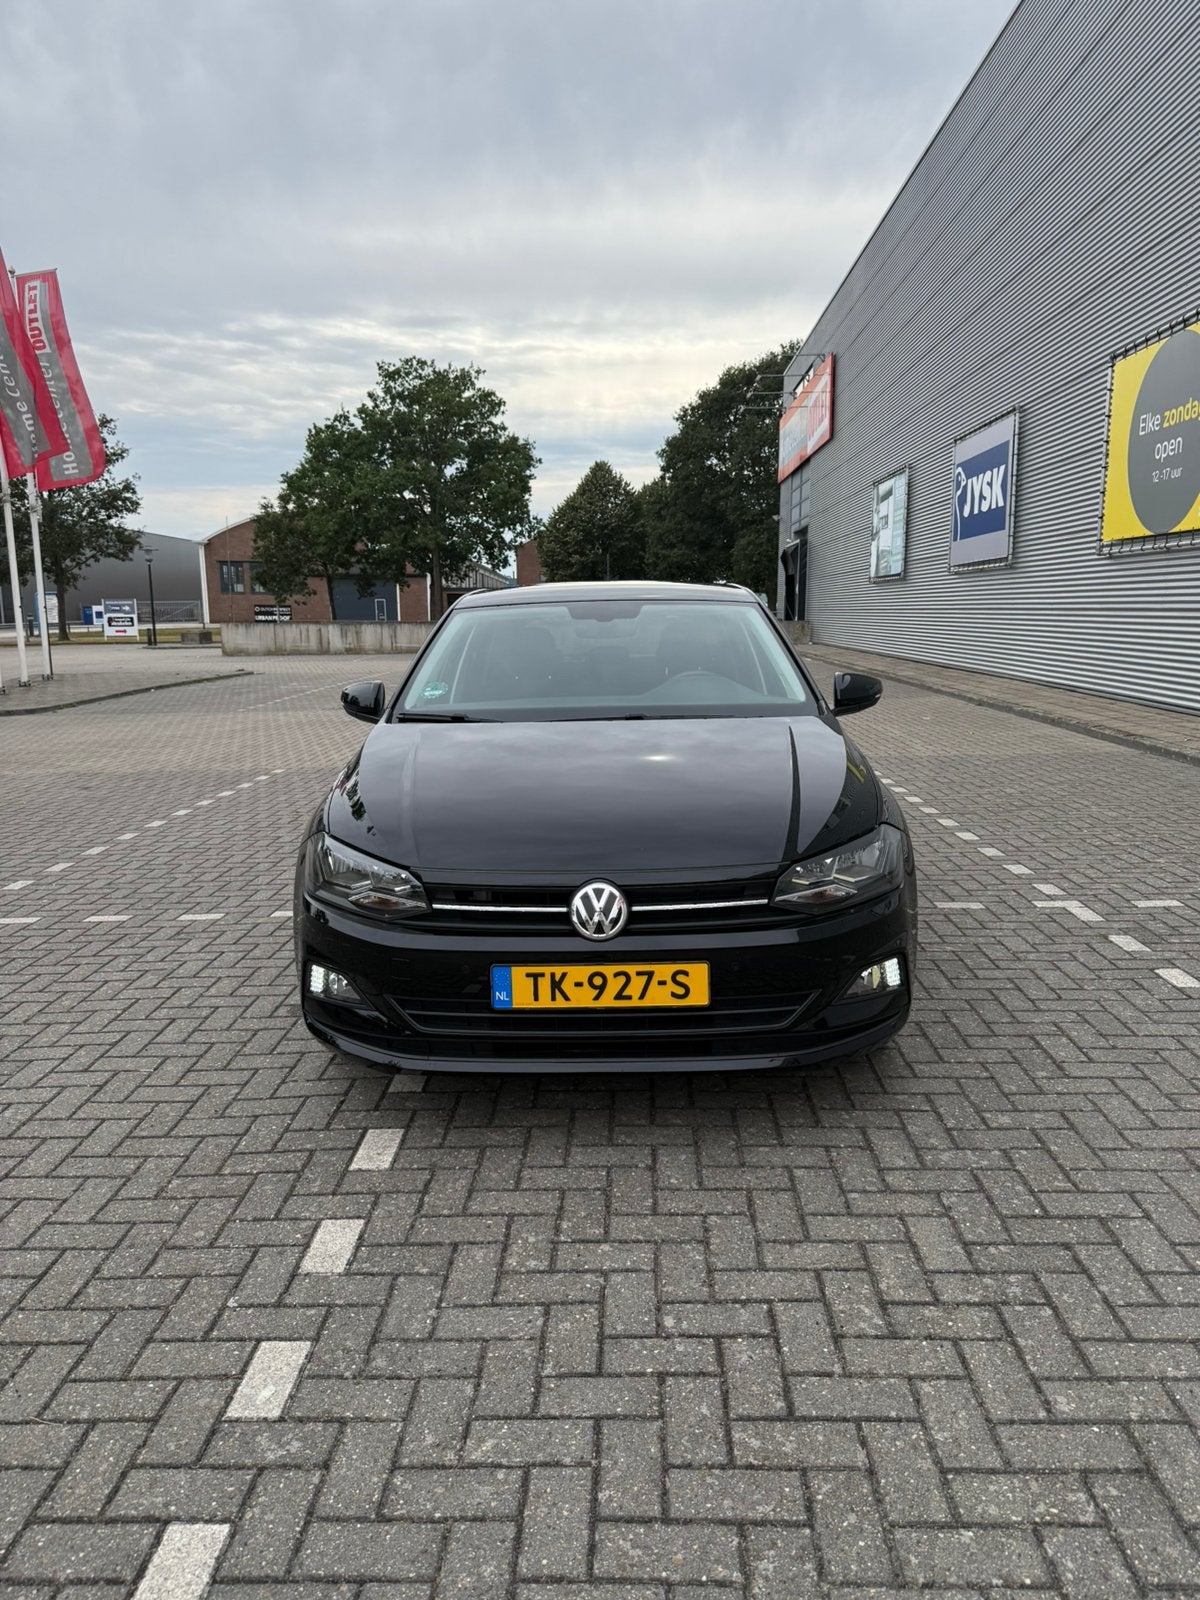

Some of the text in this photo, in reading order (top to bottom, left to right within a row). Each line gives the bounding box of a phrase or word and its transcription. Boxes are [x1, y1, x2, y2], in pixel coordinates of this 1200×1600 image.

[27, 284, 47, 353] OUTLET
[1138, 397, 1200, 436] Elke zonda
[1154, 436, 1183, 463] open
[1171, 466, 1183, 479] uur
[963, 464, 1006, 518] JYSK
[495, 991, 510, 1001] NL
[525, 969, 691, 1002] TK-927-S
